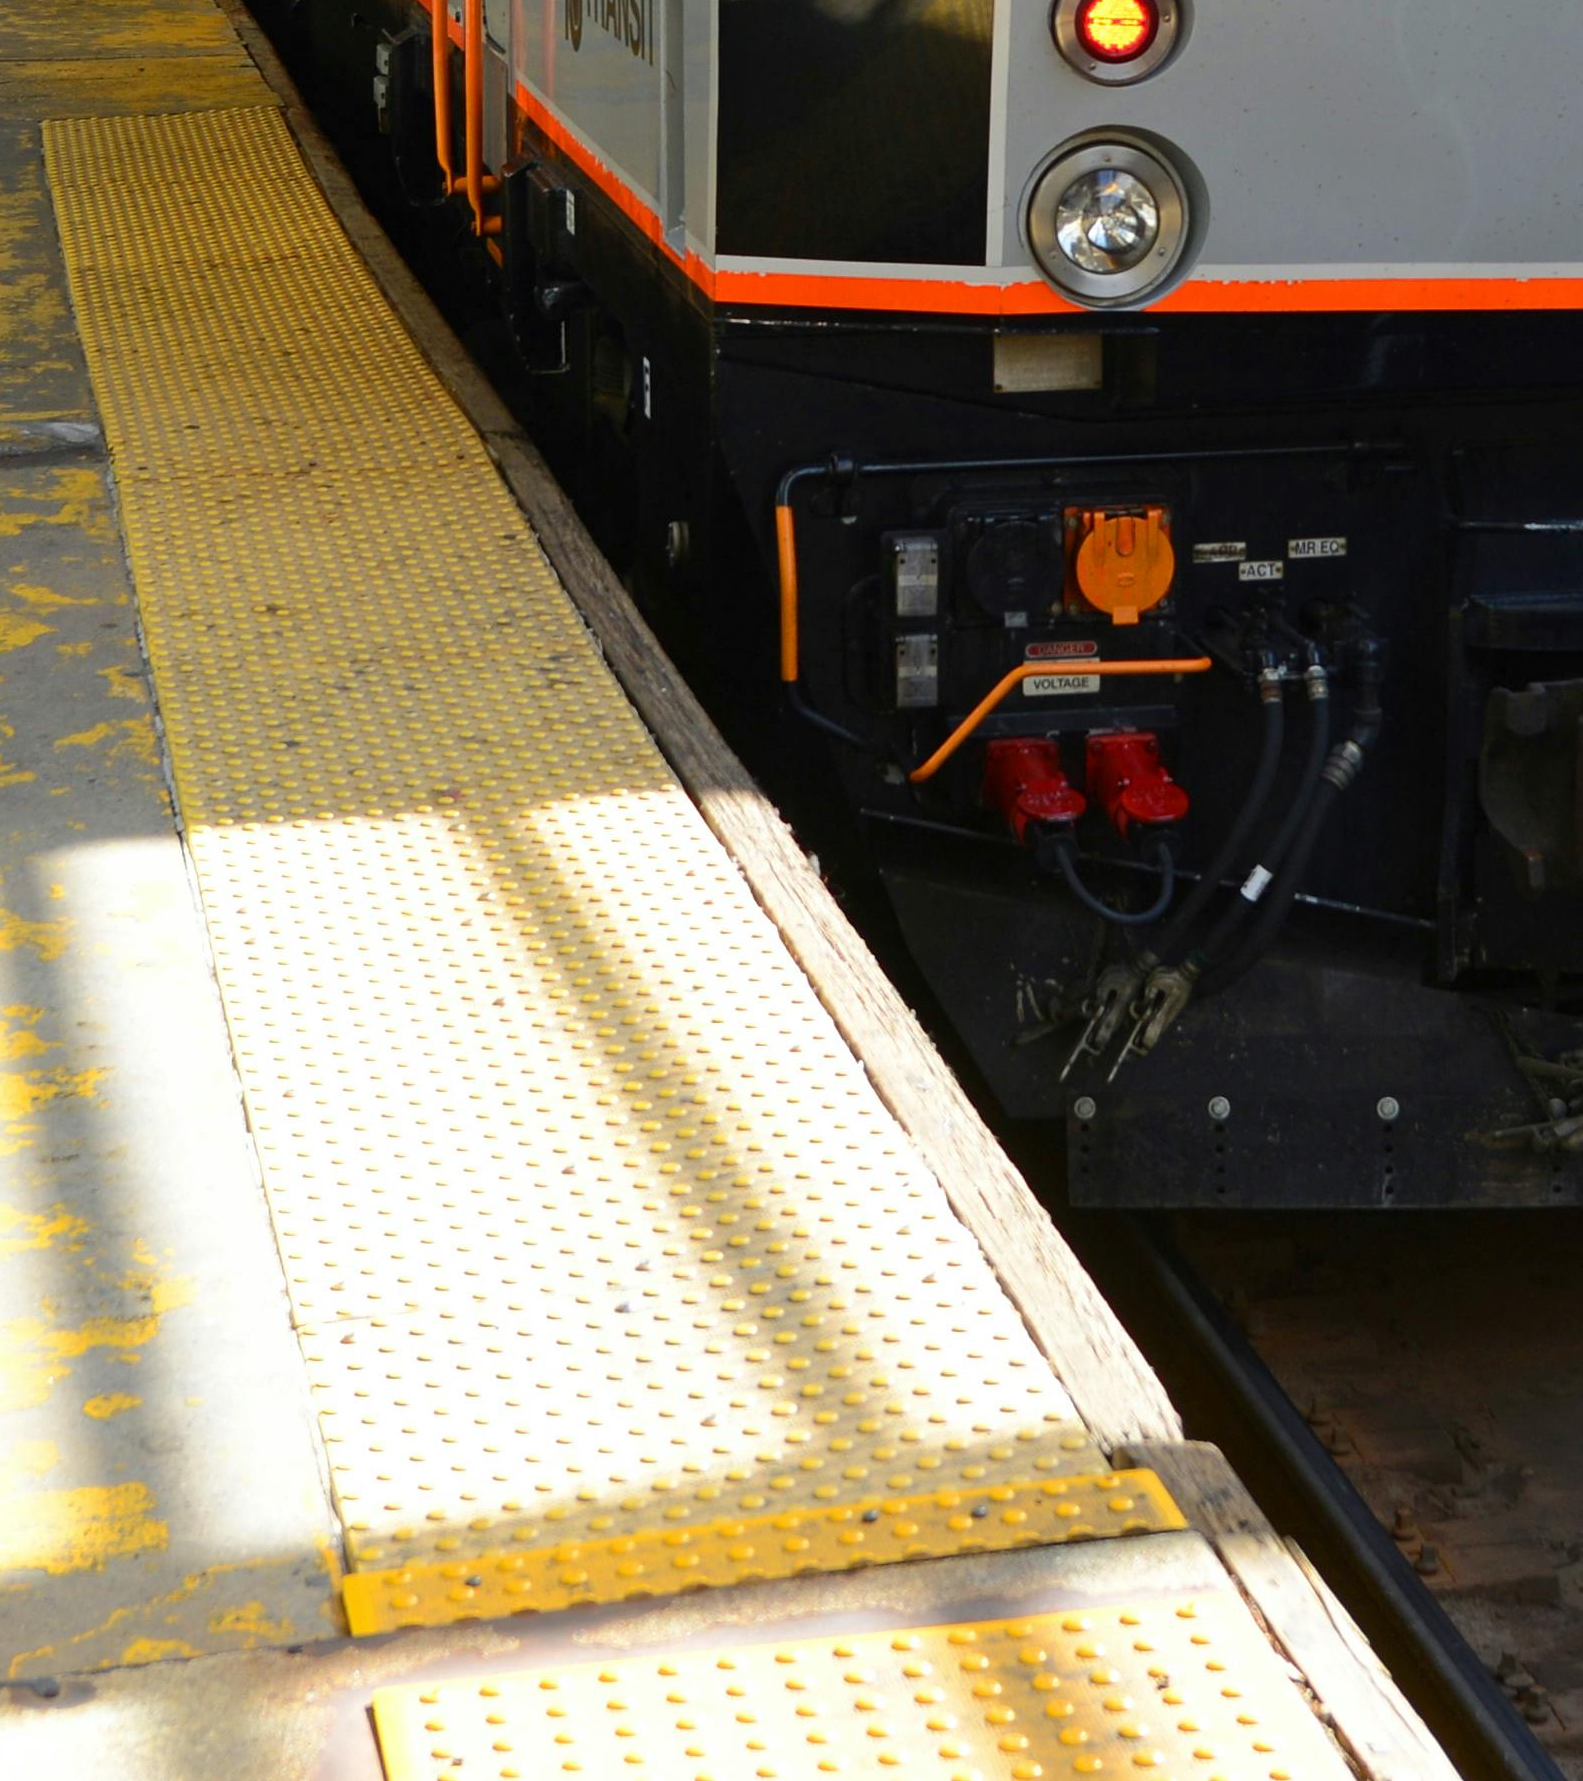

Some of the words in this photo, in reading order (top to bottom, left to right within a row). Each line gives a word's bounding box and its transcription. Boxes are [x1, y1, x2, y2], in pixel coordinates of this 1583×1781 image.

[1295, 540, 1316, 556] MR
[1246, 563, 1276, 578] ACT
[1033, 676, 1090, 690] VOLTAGE
